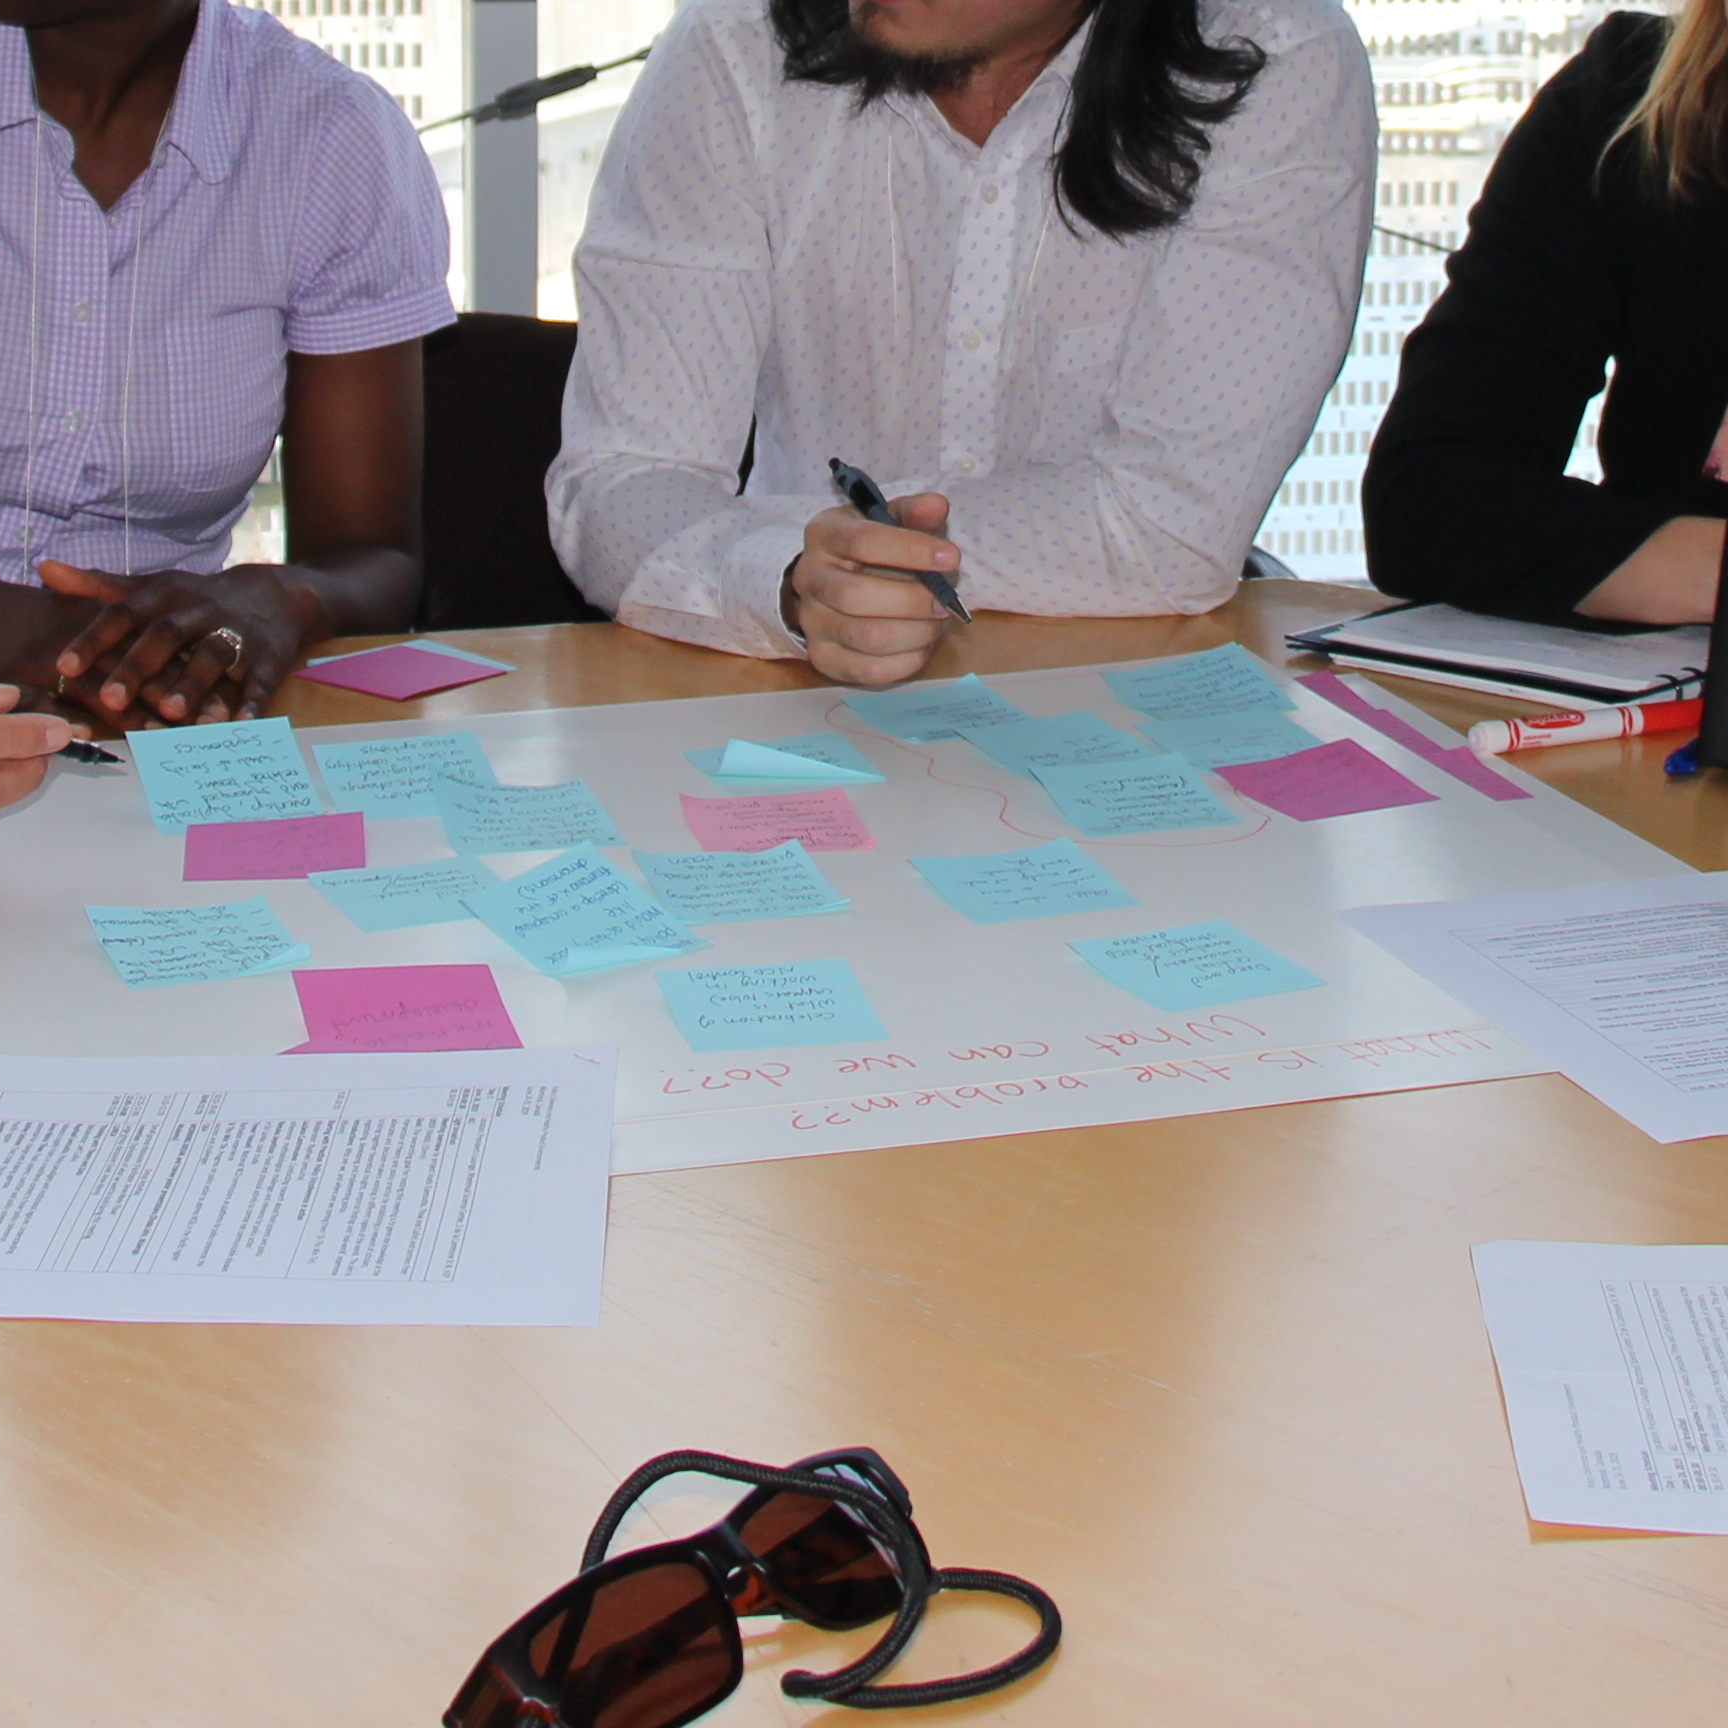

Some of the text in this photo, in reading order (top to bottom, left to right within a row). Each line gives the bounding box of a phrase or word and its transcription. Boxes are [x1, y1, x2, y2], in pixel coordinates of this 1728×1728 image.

[1084, 1014, 1266, 1057] What
[947, 1040, 1050, 1064] can
[1256, 1050, 1325, 1071] is
[1338, 1030, 1492, 1069] What
[834, 1053, 917, 1075] we
[1123, 1059, 1231, 1084] the
